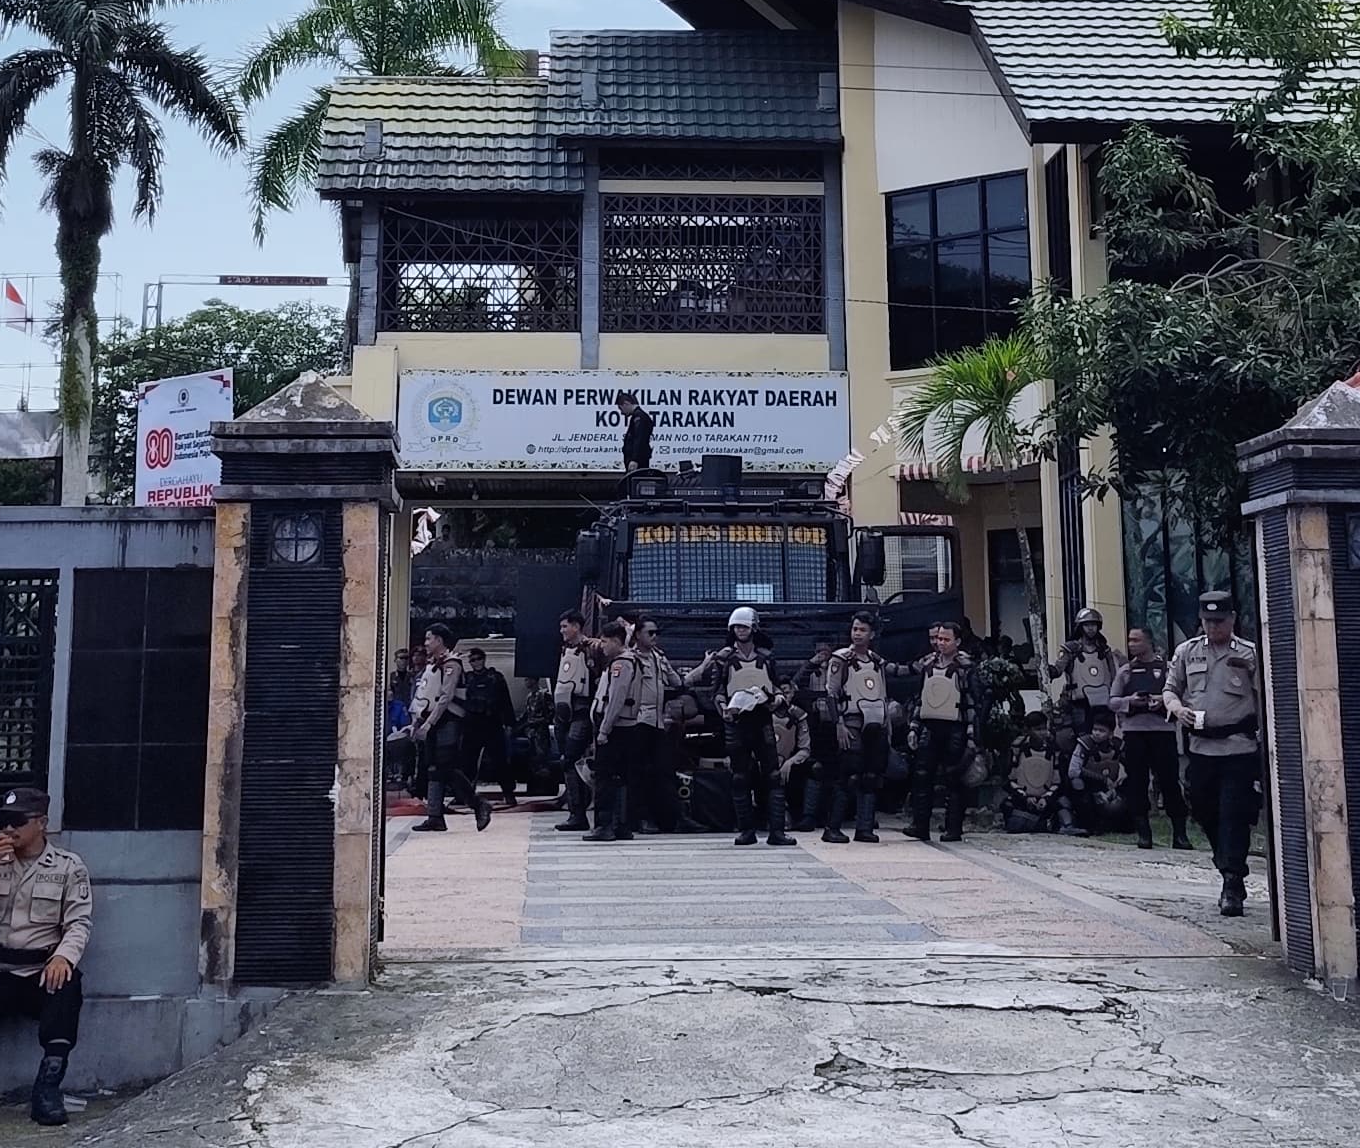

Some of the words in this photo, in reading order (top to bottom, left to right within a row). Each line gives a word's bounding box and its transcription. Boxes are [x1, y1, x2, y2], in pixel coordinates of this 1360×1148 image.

[492, 388, 557, 405] DEWAN
[689, 389, 759, 406] RAKYAT
[765, 389, 837, 407] DAERAH
[649, 410, 735, 428] TARAKAN
[430, 435, 459, 443] DPRD
[568, 433, 619, 442] JENDERAL
[704, 433, 750, 443] TARAKAN
[752, 434, 778, 443] 77112
[145, 427, 173, 470] 80
[147, 483, 214, 503] REPUBLIK
